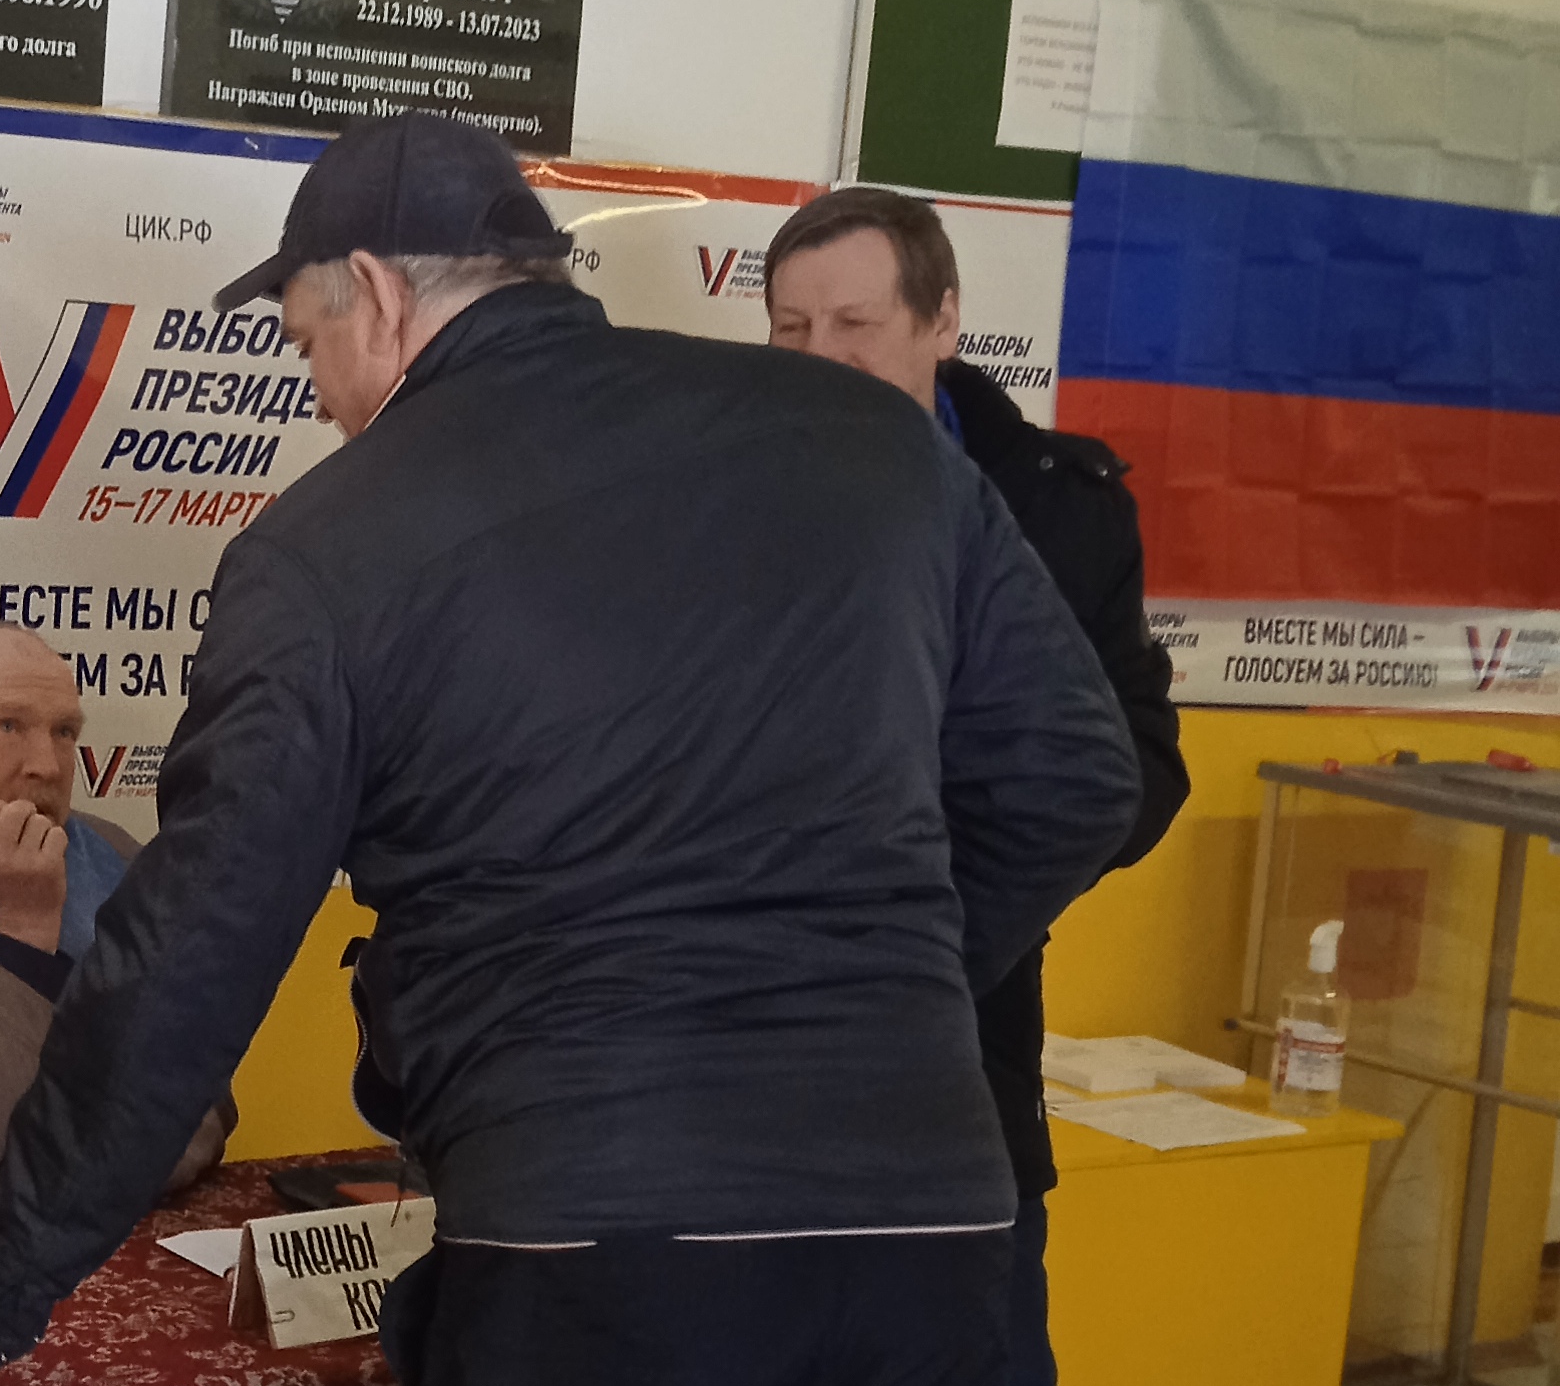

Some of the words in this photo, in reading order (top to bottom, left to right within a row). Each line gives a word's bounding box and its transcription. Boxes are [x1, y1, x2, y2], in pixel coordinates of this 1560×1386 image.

[457, 9, 542, 42] 13.07.2023
[21, 36, 77, 59] долга
[228, 28, 279, 54] Погиб
[281, 39, 313, 61] при
[315, 43, 408, 68] исполнении
[411, 52, 487, 78] воинского
[490, 62, 532, 83] долга
[208, 80, 296, 111] Награжден
[300, 92, 369, 118] Орденом
[291, 69, 301, 83] в
[304, 70, 339, 87] зоне
[342, 74, 430, 100] проведения
[433, 81, 474, 102] СВО.
[125, 213, 212, 246] ЦИК.РФ
[153, 308, 286, 357] ВЫБО
[957, 333, 1034, 358] ВЫБОРЫ
[131, 368, 317, 424] ПРЕЗИДЕ
[101, 428, 281, 478] РОССИИ
[78, 485, 172, 524] 15–17
[106, 587, 175, 631] МЫ
[1244, 617, 1317, 646] ВМЕСТЕ
[1322, 621, 1357, 647] МЫ
[1360, 623, 1408, 649] СИЛА
[120, 653, 167, 697] ЗА
[1224, 655, 1324, 685] ГОЛОСУЕМ
[1327, 658, 1351, 685] ЗА
[1354, 660, 1438, 688] РОССИЮ!
